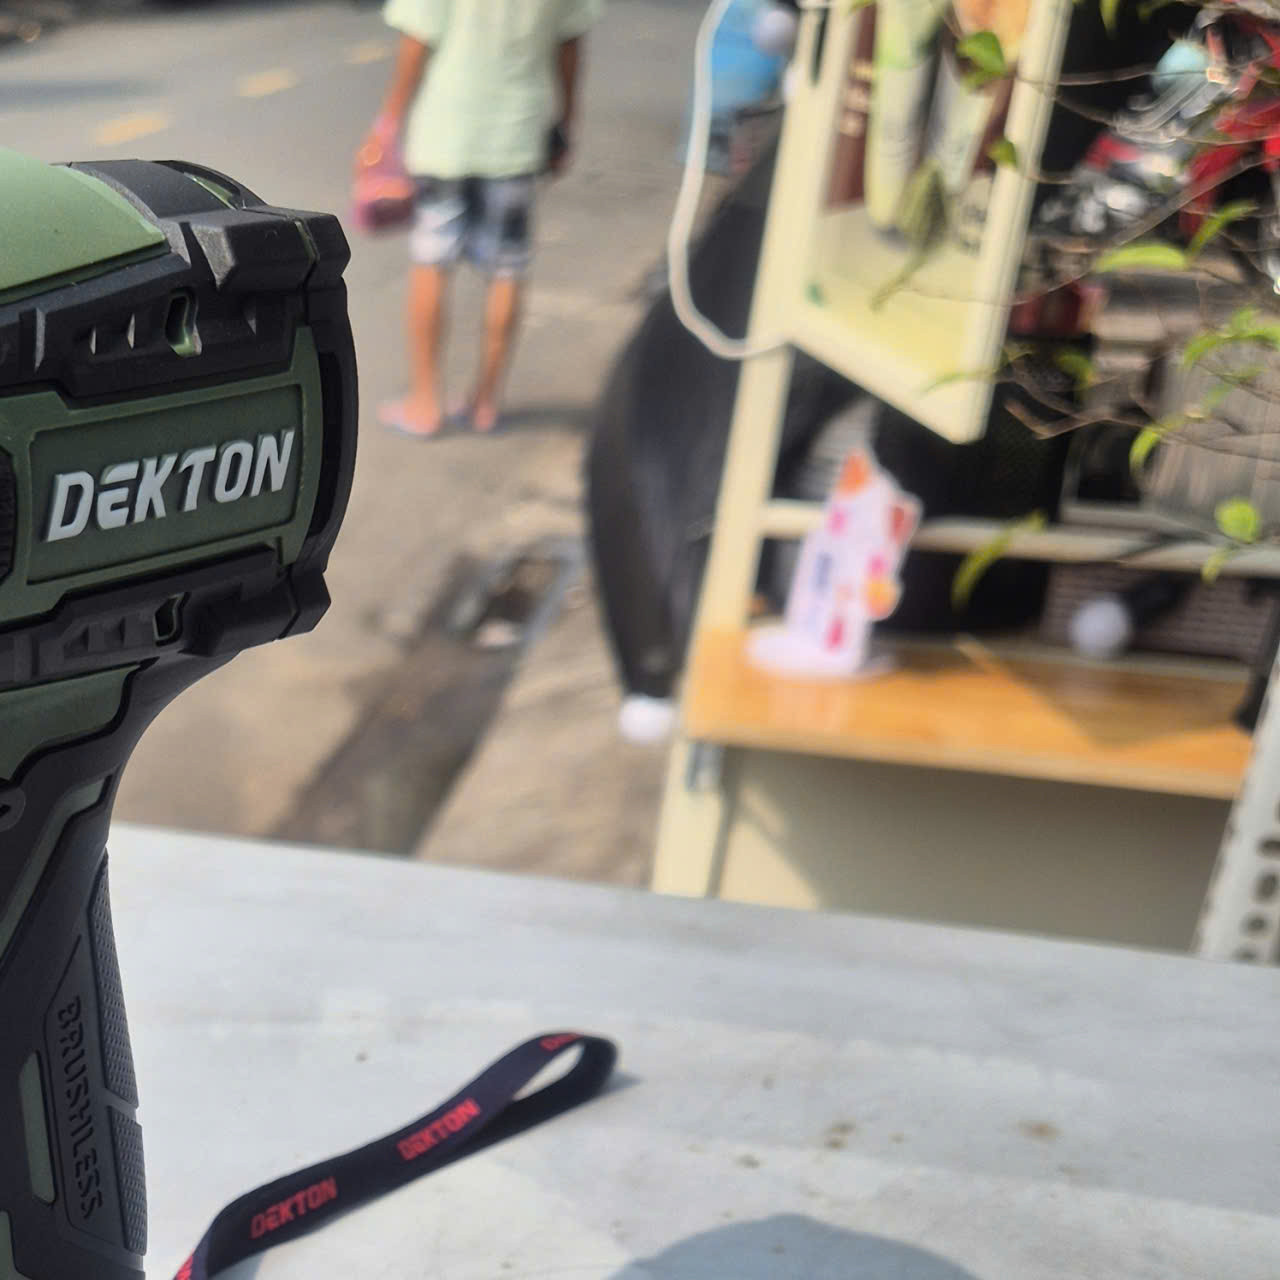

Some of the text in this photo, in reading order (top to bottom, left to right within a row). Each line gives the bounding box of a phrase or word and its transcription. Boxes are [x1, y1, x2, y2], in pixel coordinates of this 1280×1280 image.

[46, 428, 296, 543] DEKTON
[57, 996, 104, 1220] BRUSHLESS
[396, 1097, 481, 1161] DEKTON
[250, 1176, 338, 1240] DEKTON
